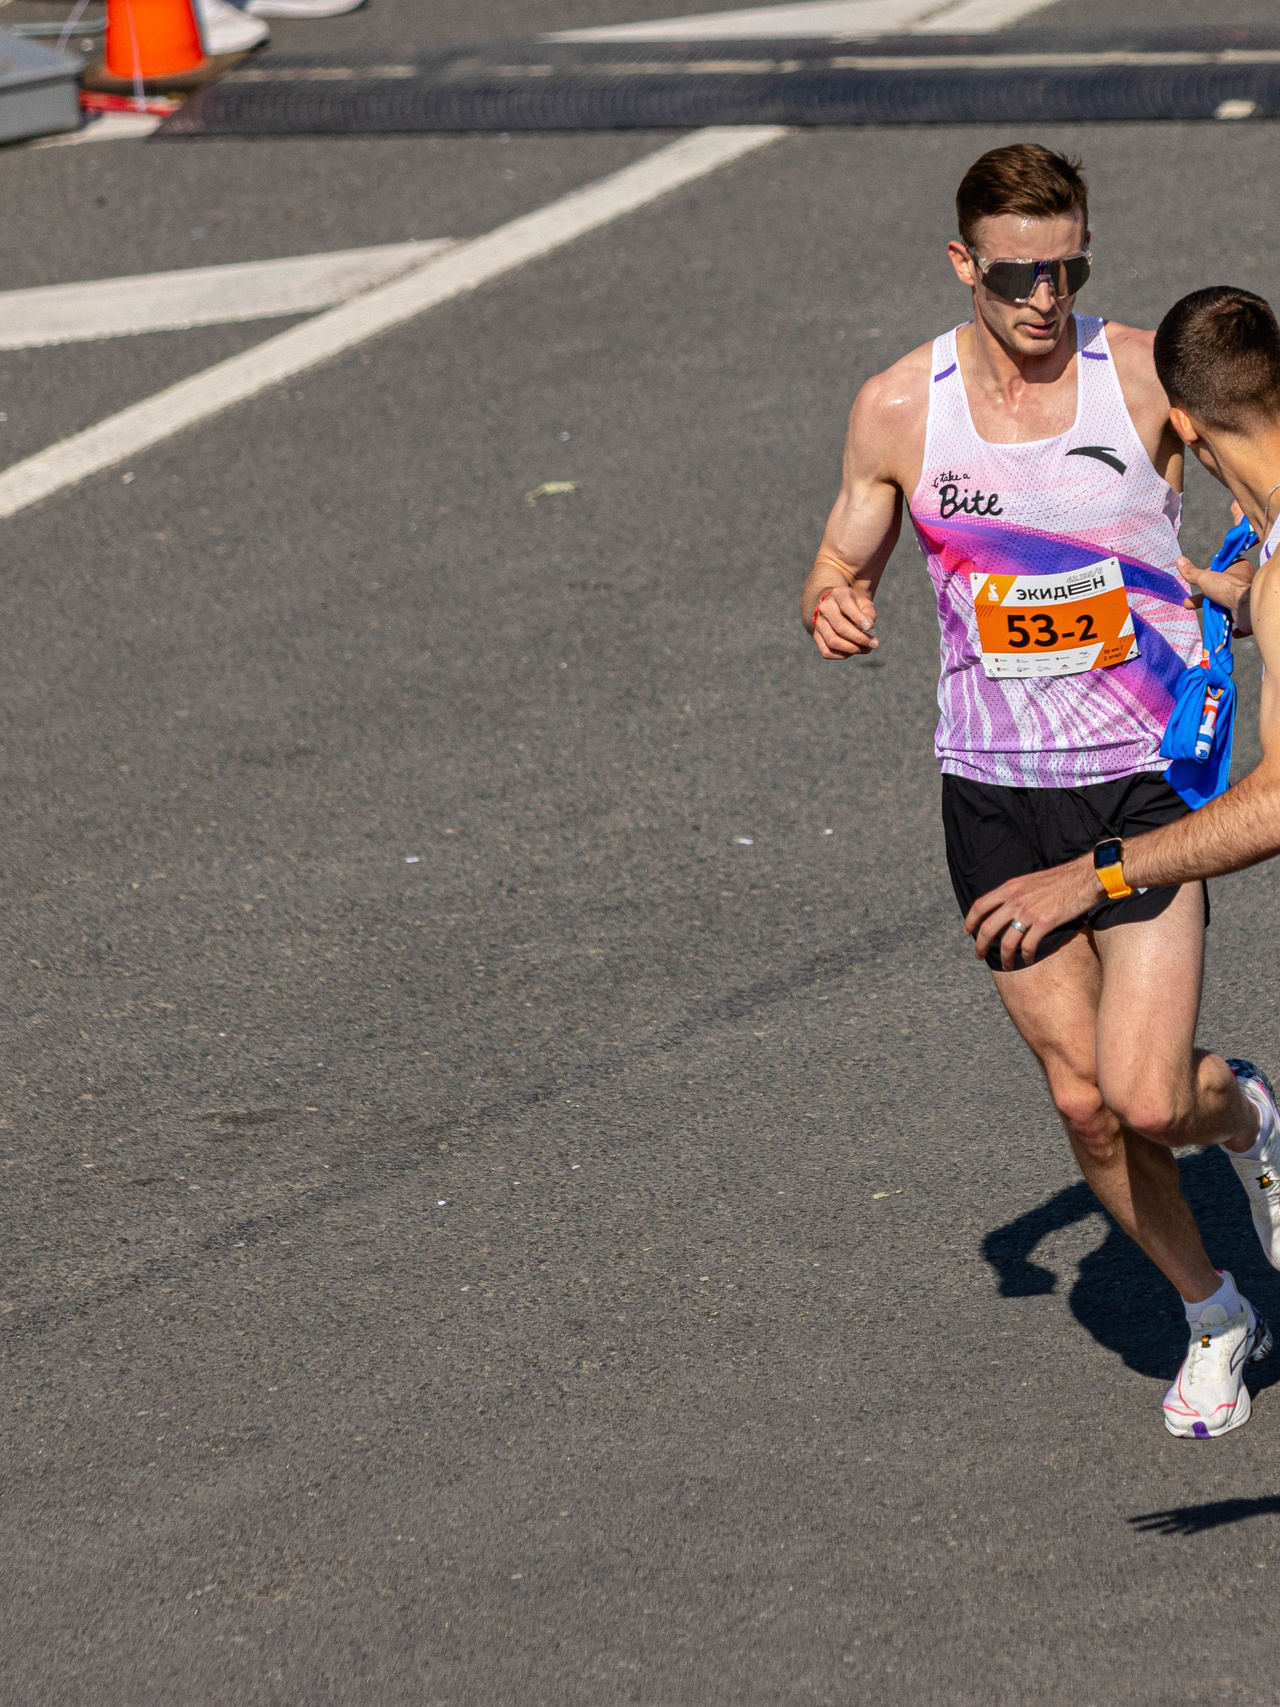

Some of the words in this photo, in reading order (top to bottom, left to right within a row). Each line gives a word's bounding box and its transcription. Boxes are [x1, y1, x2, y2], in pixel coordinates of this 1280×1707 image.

[940, 470, 962, 482] take
[939, 484, 1003, 519] Bite
[1016, 575, 1106, 600] ЭКИДЕН
[1007, 613, 1098, 648] 53-2
